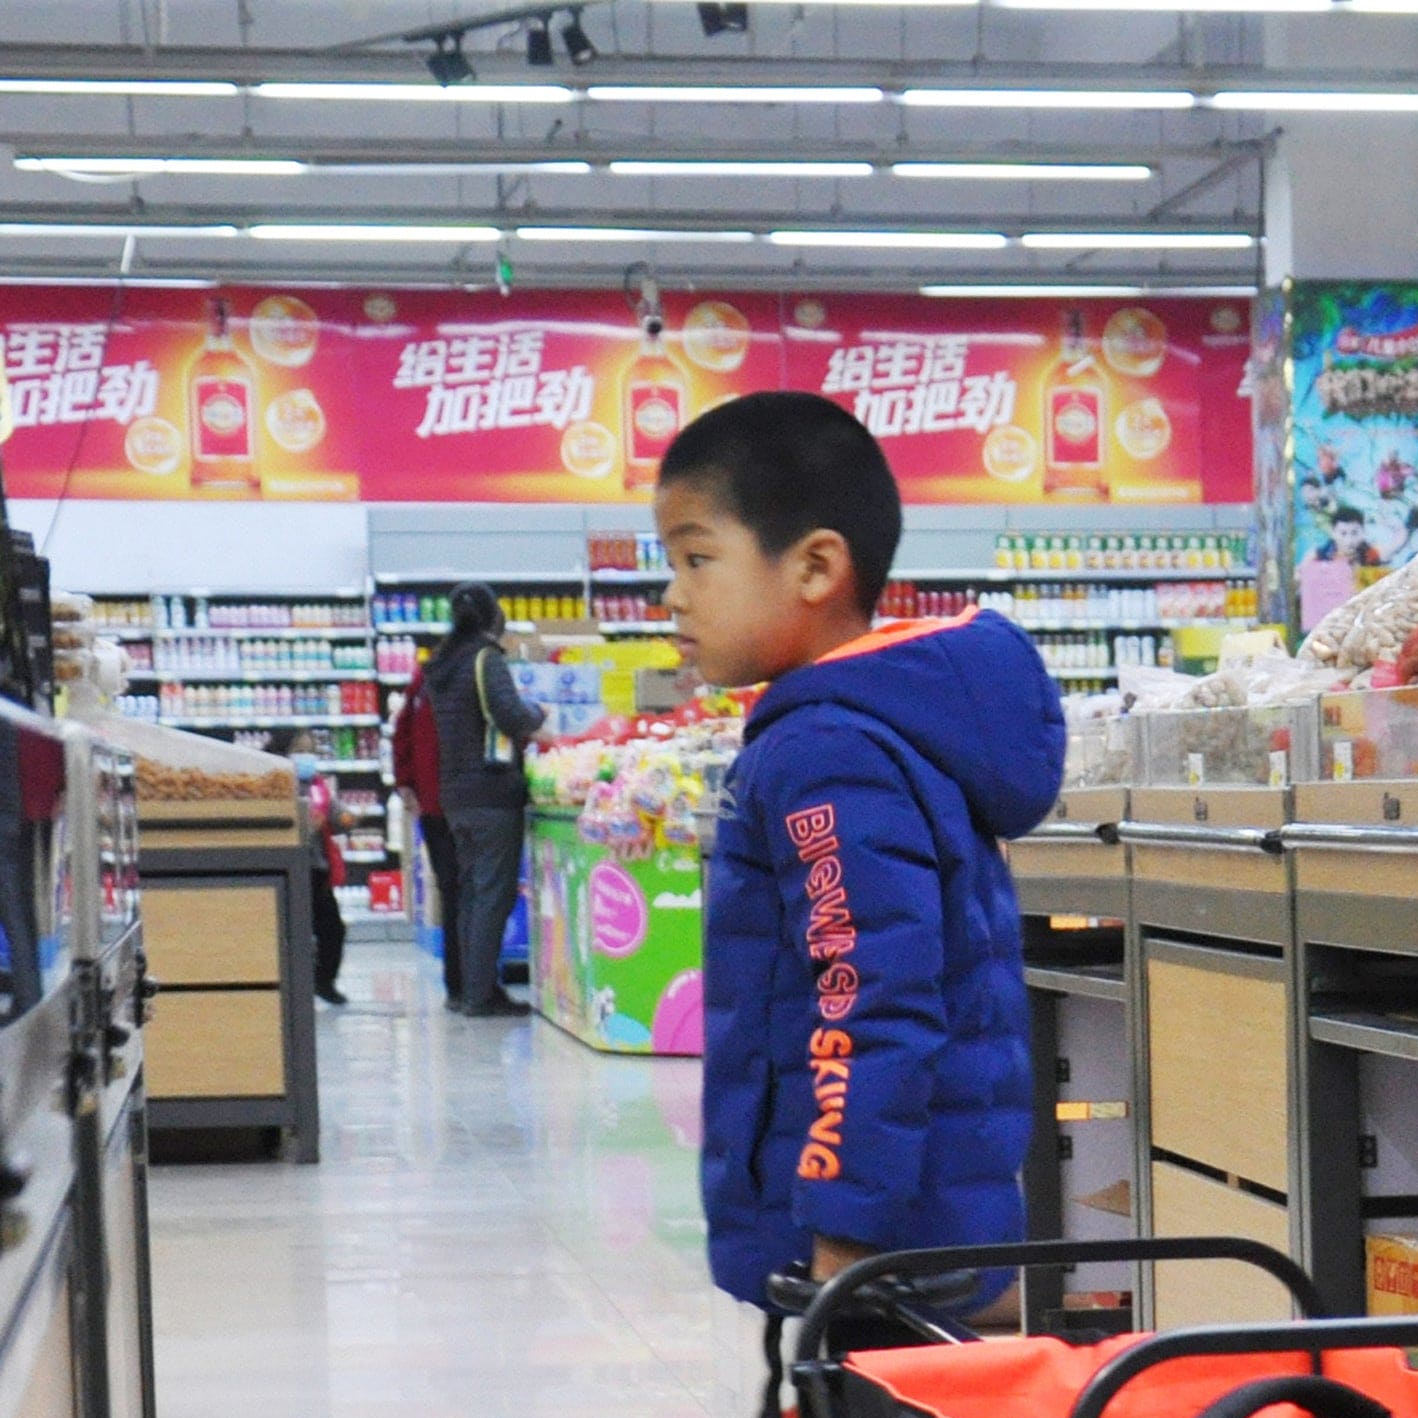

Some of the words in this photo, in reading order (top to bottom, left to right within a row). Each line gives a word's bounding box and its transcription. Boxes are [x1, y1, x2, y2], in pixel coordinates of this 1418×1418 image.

[0, 329, 106, 376] 生活
[393, 331, 546, 388] 给生活
[820, 335, 970, 394] 给生活
[416, 365, 595, 438] 加把劲
[853, 370, 1017, 438] 加把劲
